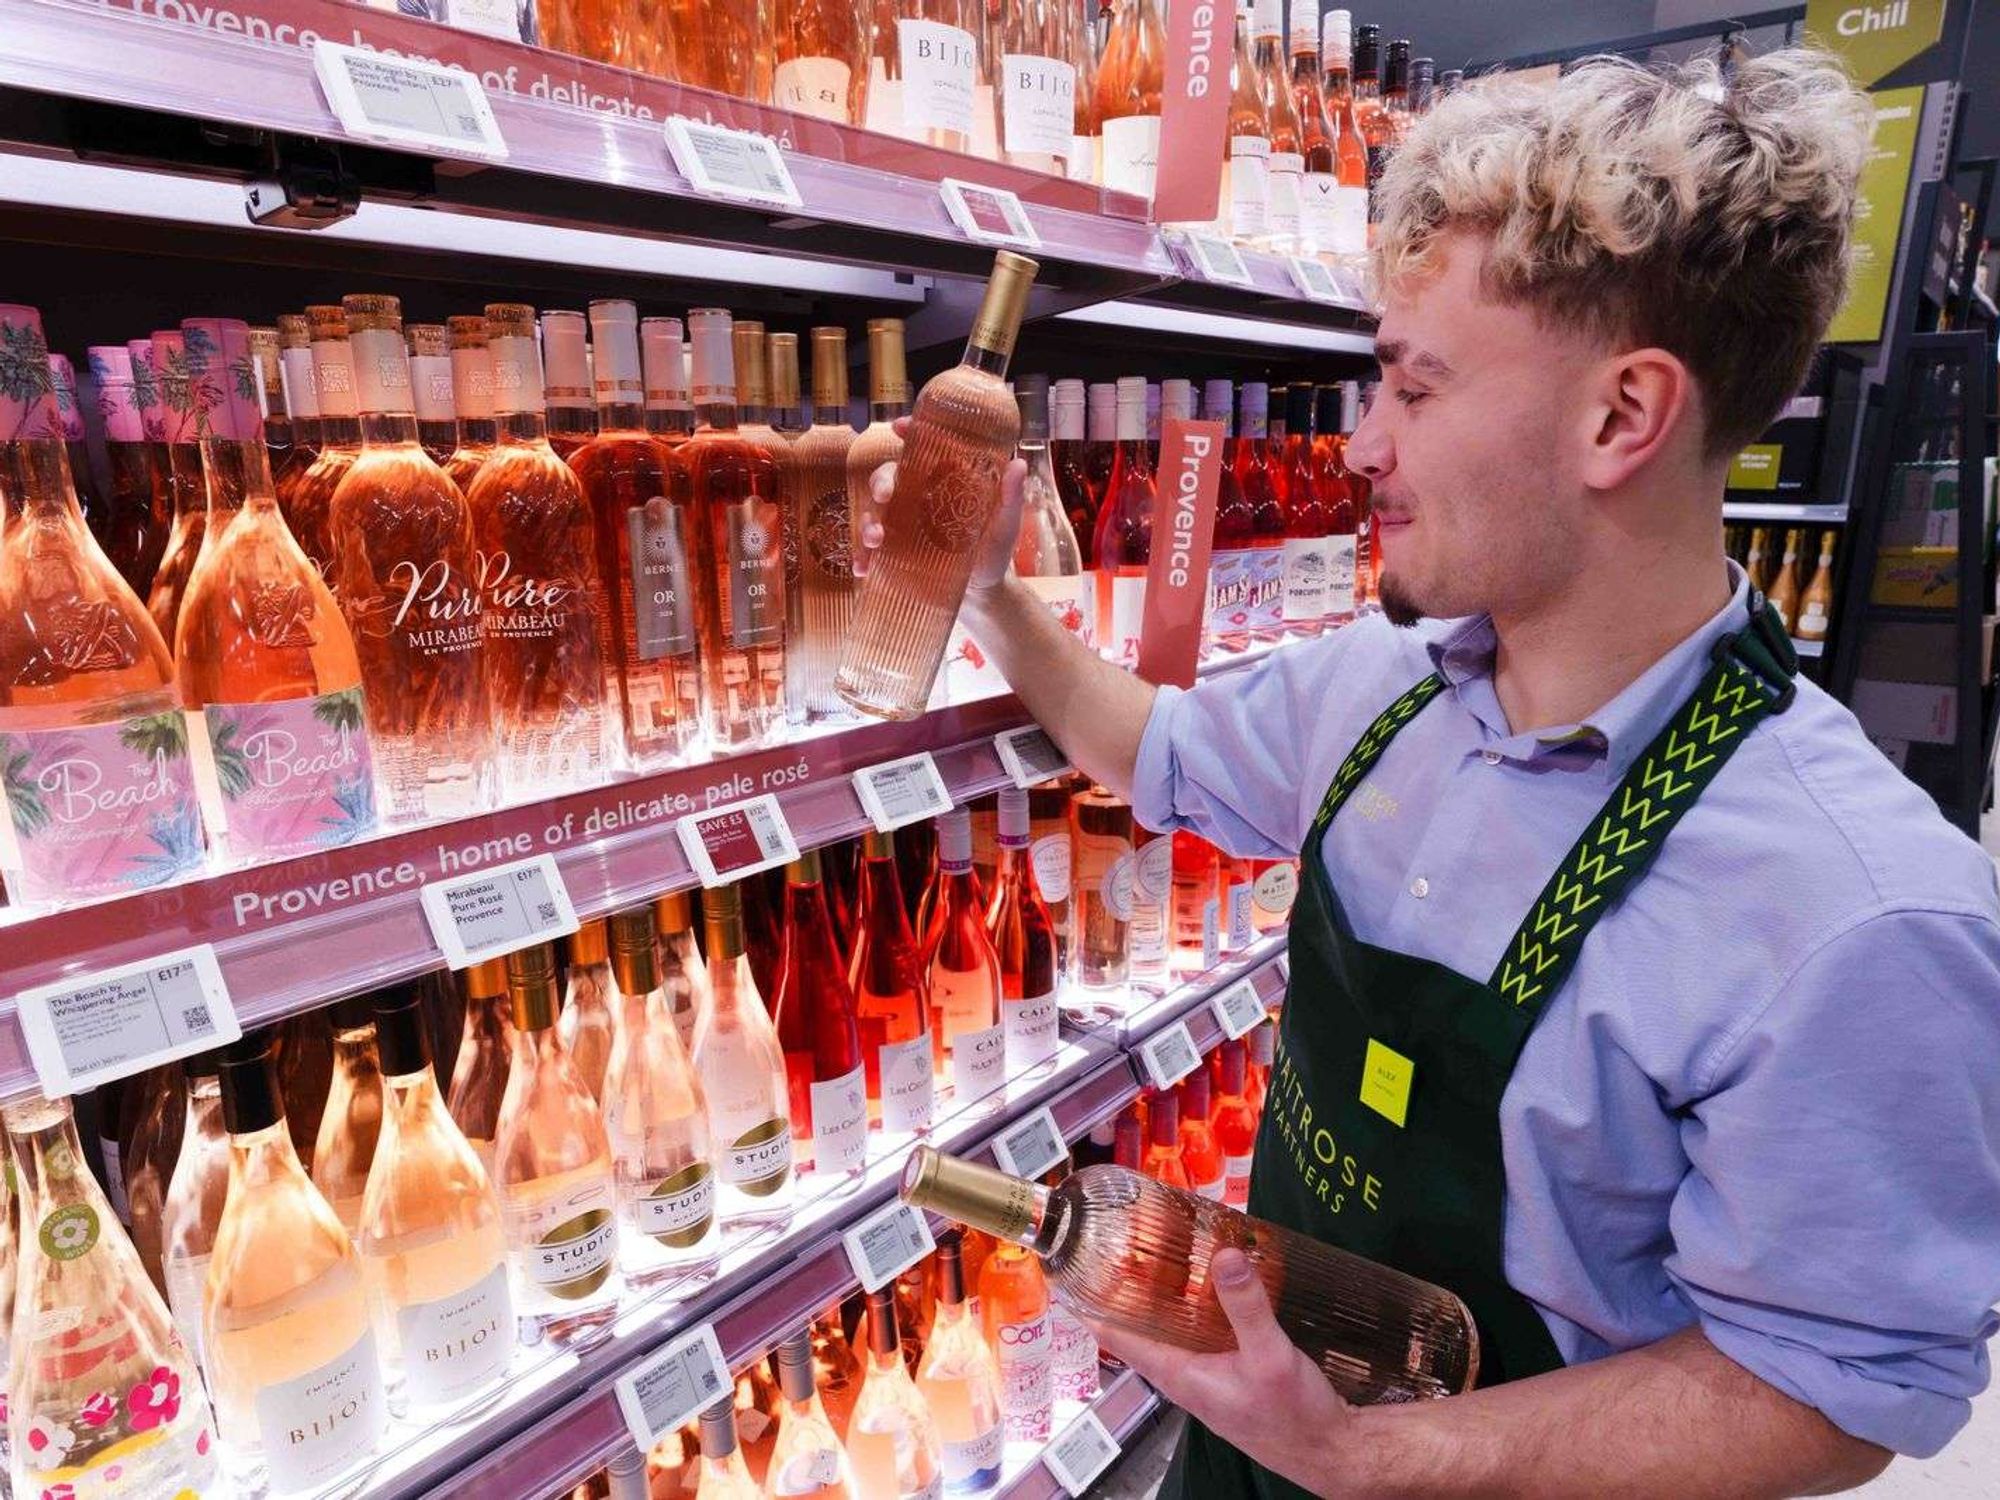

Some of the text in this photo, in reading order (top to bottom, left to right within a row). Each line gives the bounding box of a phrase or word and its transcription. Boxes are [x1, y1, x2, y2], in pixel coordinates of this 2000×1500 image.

[1836, 2, 1908, 36] Chill
[1186, 0, 1215, 98] ence
[481, 66, 518, 97] of
[1169, 434, 1212, 588] Provence
[475, 550, 572, 608] Pure
[747, 583, 768, 597] OR
[653, 590, 676, 604] OR
[243, 719, 358, 788] Beach
[38, 746, 177, 824] Beach
[233, 757, 810, 927] Provence, home of delicate, pale rosé
[697, 817, 729, 834] SAVE
[447, 884, 494, 902] Mirabeau
[452, 892, 504, 914] Pure Rosé
[455, 906, 504, 925] Provence
[51, 984, 123, 1008] The Beach by
[54, 986, 147, 1018] Whispering Angel
[1273, 1097, 1345, 1224] PARTNERS
[543, 1227, 614, 1265] STUDIO
